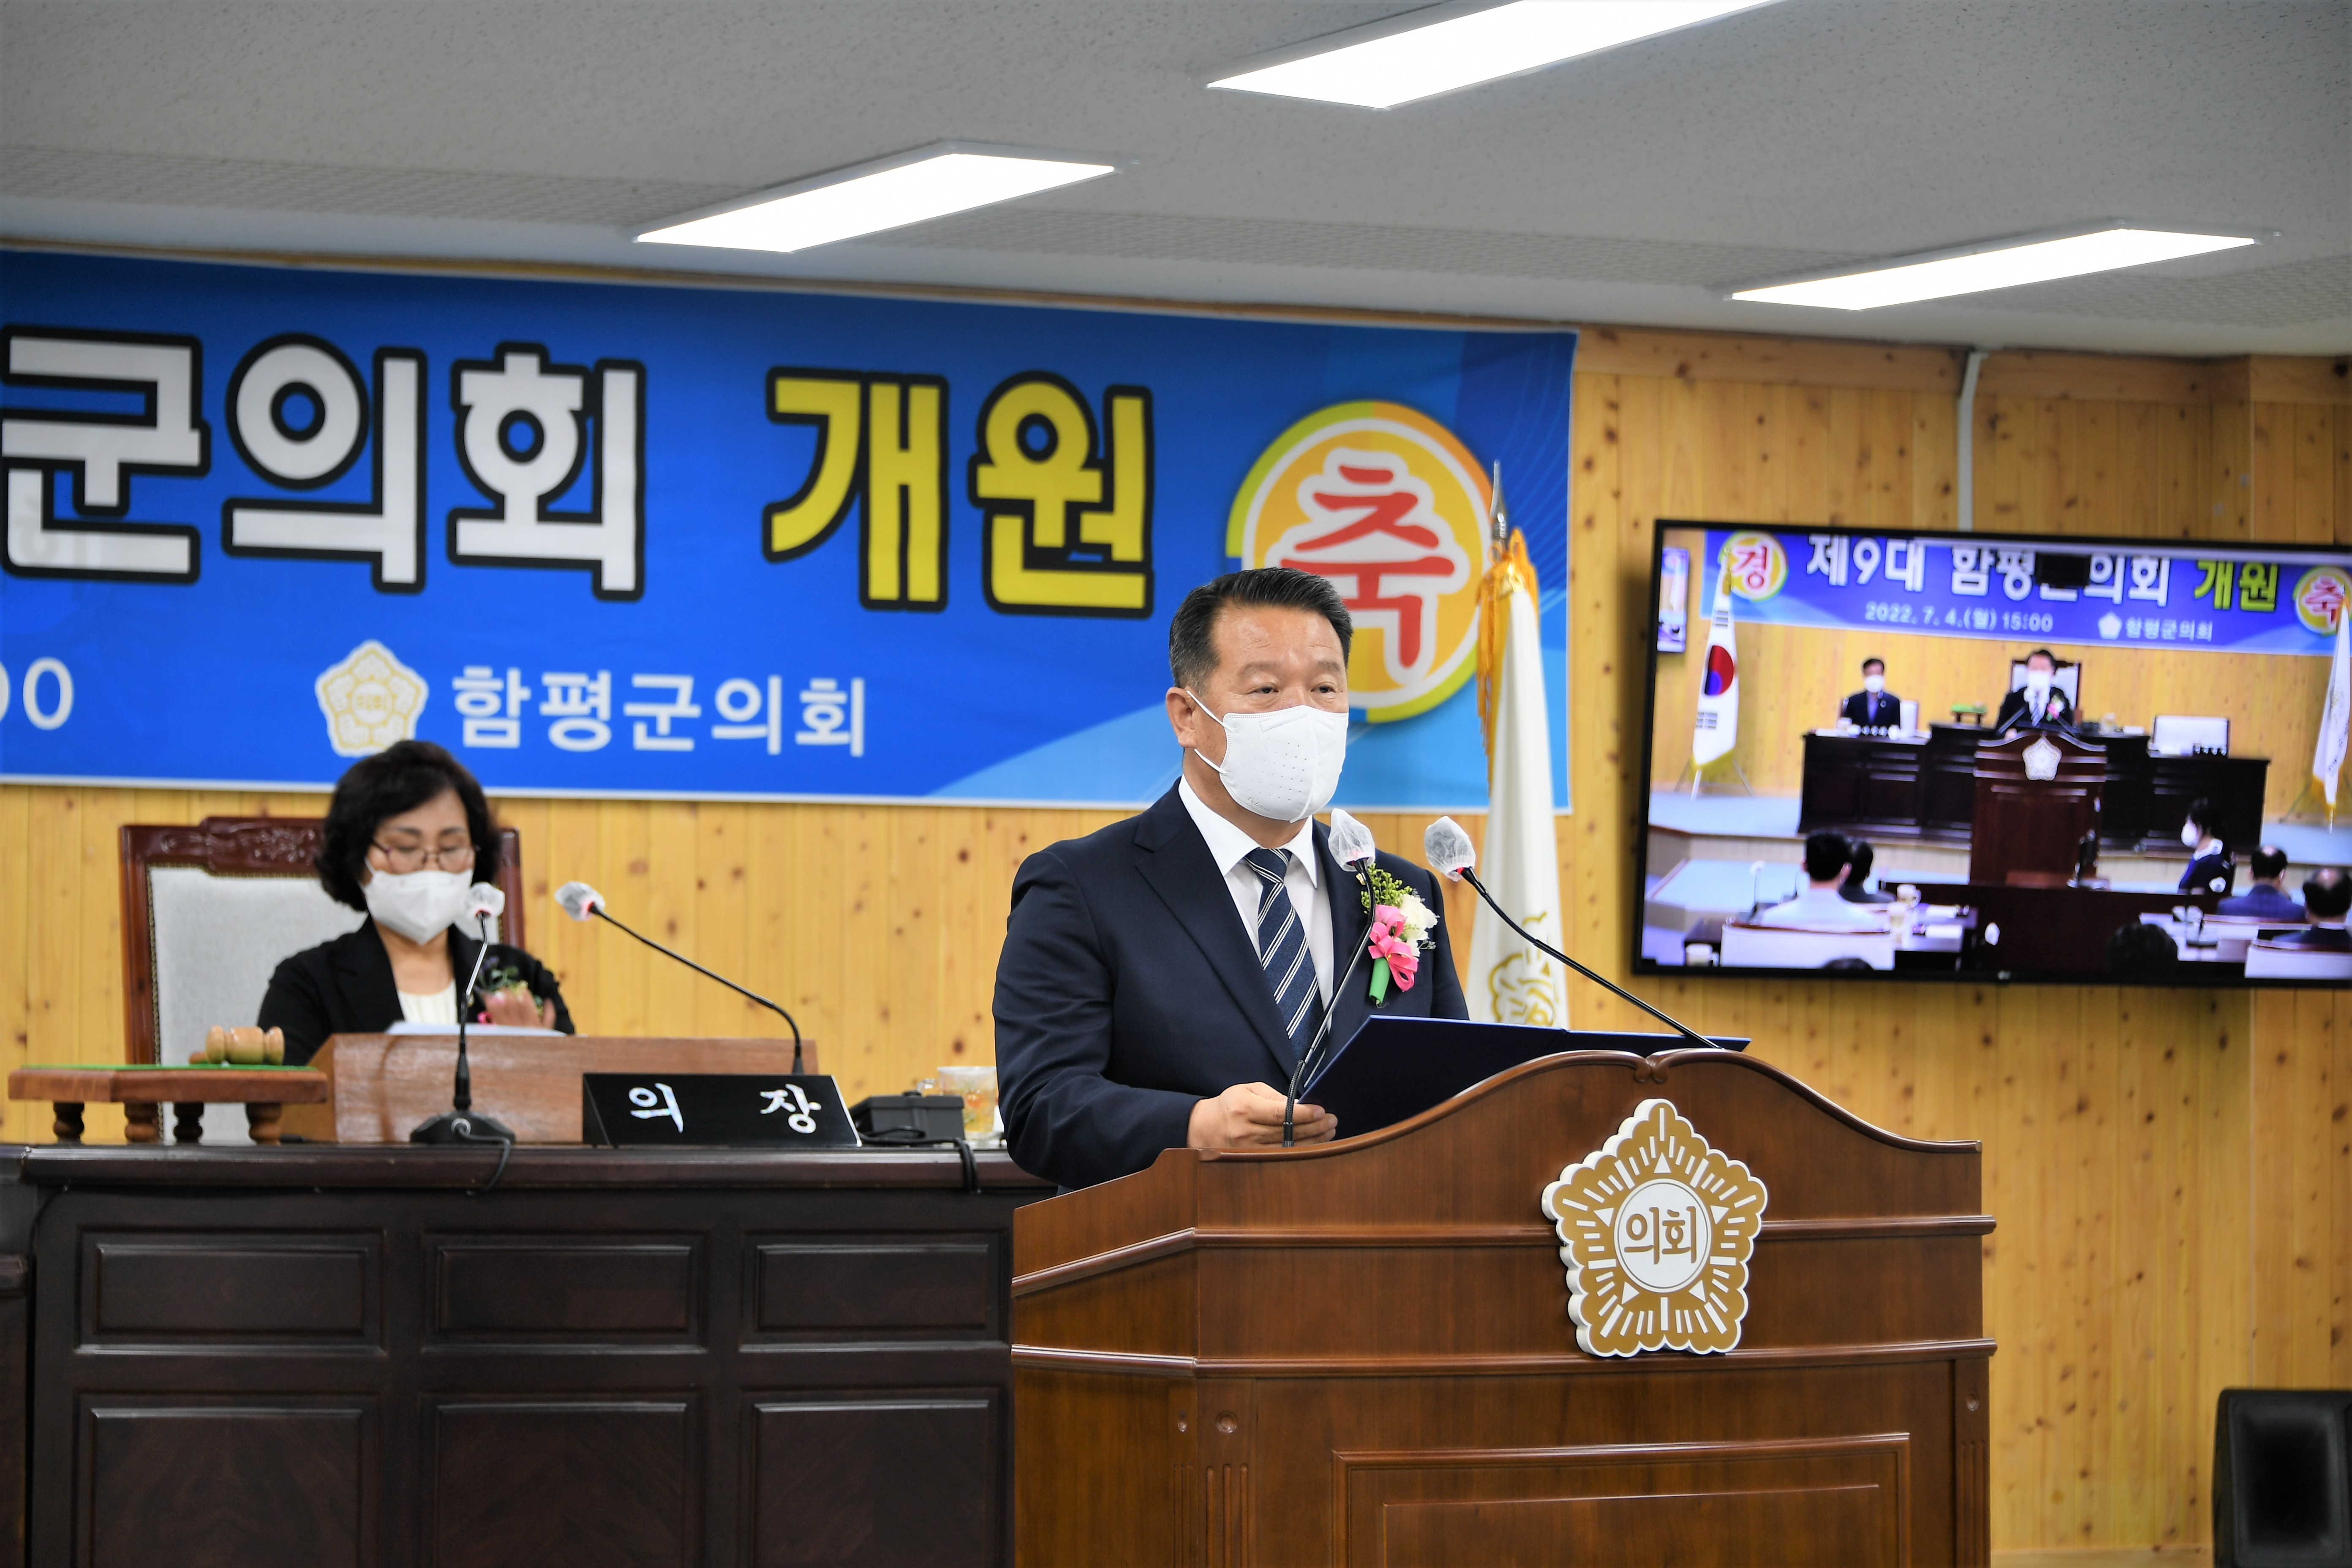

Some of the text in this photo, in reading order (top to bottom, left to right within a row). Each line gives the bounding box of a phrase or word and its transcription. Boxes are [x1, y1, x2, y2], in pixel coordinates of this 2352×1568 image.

[0, 325, 1154, 620] 군의회 개원
[1280, 465, 1455, 669] 축
[1733, 545, 1769, 590] 경
[1806, 534, 1926, 592] 제9대
[2194, 559, 2279, 612] 개원
[1865, 601, 1918, 625] 2022.
[2002, 612, 2053, 632] 15:00
[0, 655, 74, 731] 0
[451, 664, 865, 757] 함평군의회
[1624, 1206, 1697, 1265] 의회
